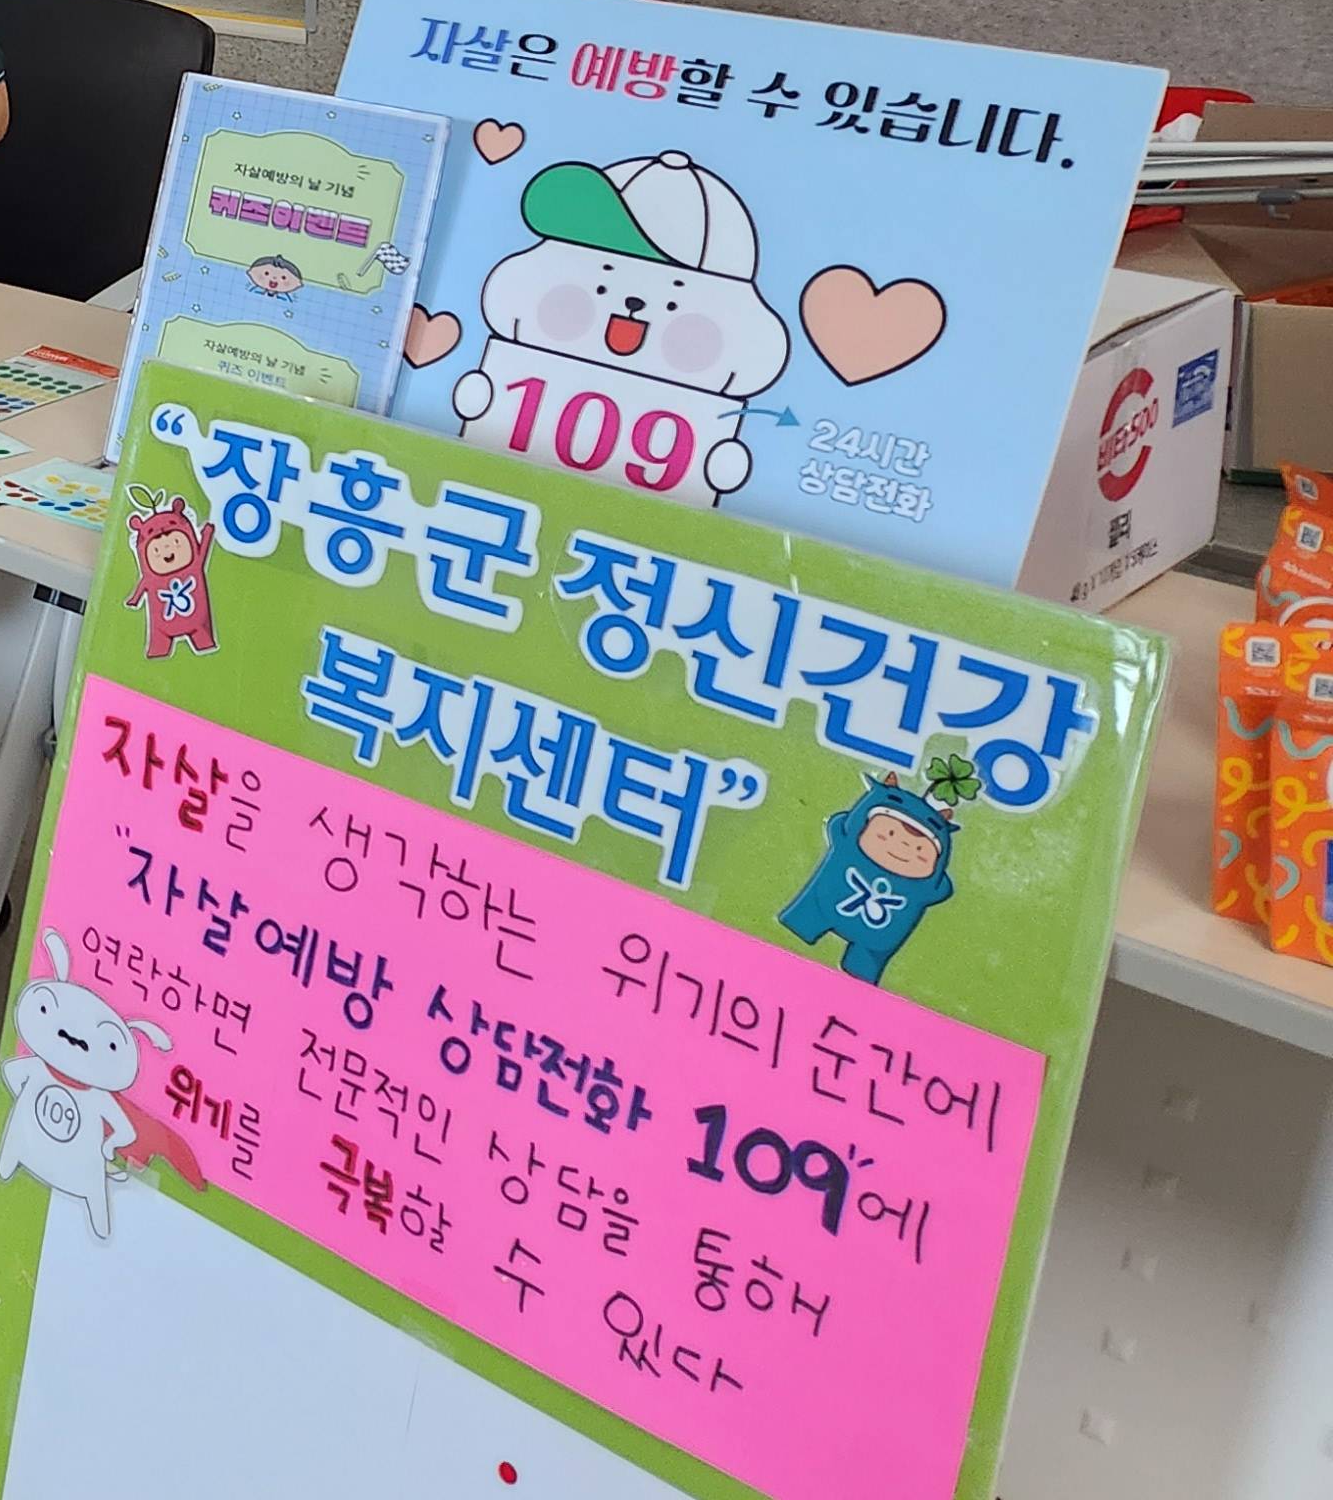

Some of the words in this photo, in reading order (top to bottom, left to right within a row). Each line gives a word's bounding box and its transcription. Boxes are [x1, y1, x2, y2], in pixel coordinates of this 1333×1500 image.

[409, 16, 559, 82] 자살은
[570, 42, 735, 110] 예방할
[746, 71, 801, 119] 수
[814, 80, 1075, 170] 있습니다.
[233, 162, 304, 189] 자살예방의
[307, 177, 322, 192] 날
[325, 181, 356, 199] 기념
[203, 338, 263, 365] 자살예방의
[266, 355, 278, 369] 날
[280, 360, 307, 377] 기념
[217, 359, 243, 377] 퀴즈
[247, 367, 287, 389] 이벤트
[505, 376, 697, 493] 109
[797, 457, 933, 523] 상담전화
[806, 418, 932, 477] 24시간
[558, 538, 1094, 807] 정신건강
[102, 715, 262, 852] 자살을
[308, 805, 537, 981] 생각하는
[601, 933, 785, 1069] 위기의
[812, 1014, 1001, 1153] 순간에
[41, 1095, 77, 1136] 109
[426, 983, 653, 1135] 상담전화
[82, 925, 252, 1056] 연락하면
[298, 1028, 453, 1165] 전문적인
[488, 1130, 640, 1257] 상담을
[693, 1226, 831, 1337] 통해
[164, 1064, 262, 1181] 위기를
[319, 1133, 453, 1254] 극복할
[493, 1237, 545, 1313] 수
[603, 1289, 744, 1392] 있다
